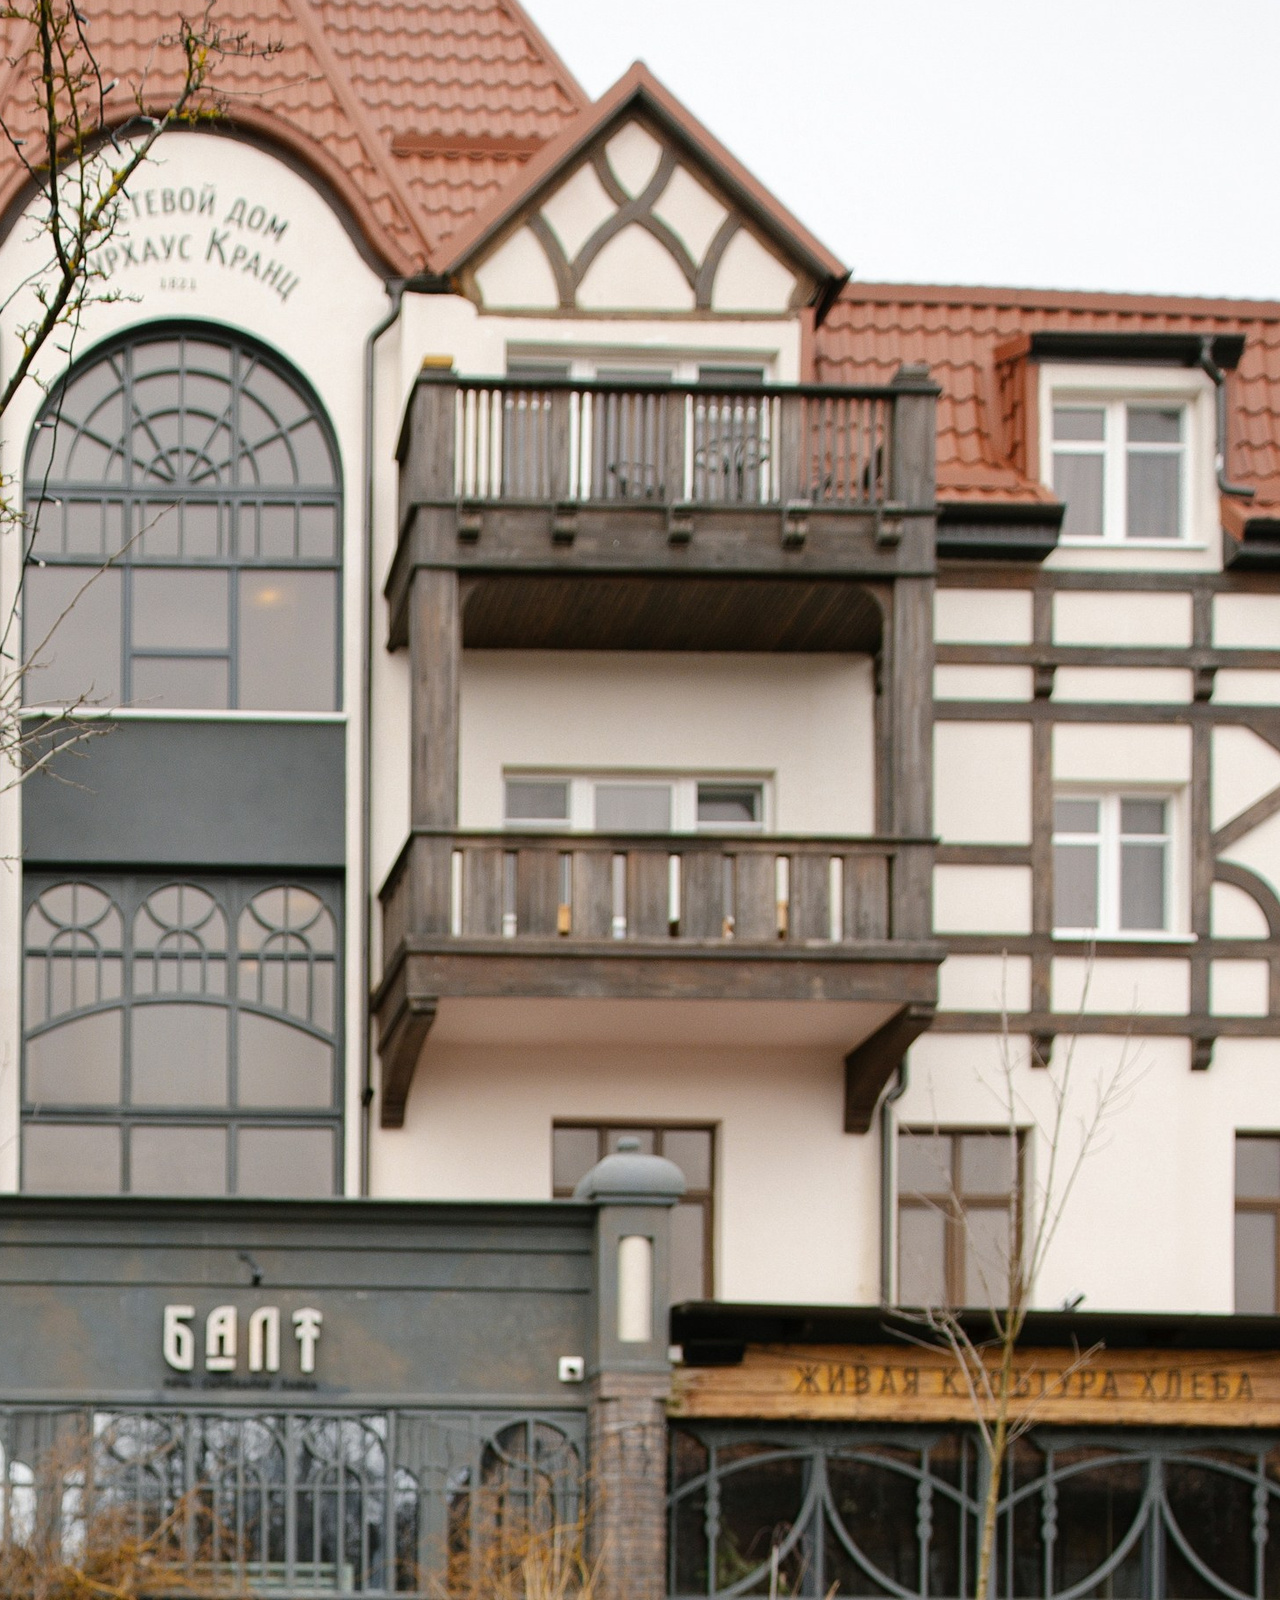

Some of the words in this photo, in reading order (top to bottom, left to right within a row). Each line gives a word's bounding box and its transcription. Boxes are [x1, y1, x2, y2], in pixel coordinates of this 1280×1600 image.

[223, 197, 288, 243] ДОМ
[82, 233, 192, 275] УРХАУС
[795, 1364, 919, 1396] ЖИВАЯ
[1140, 1368, 1253, 1401] ХЛЕБА
